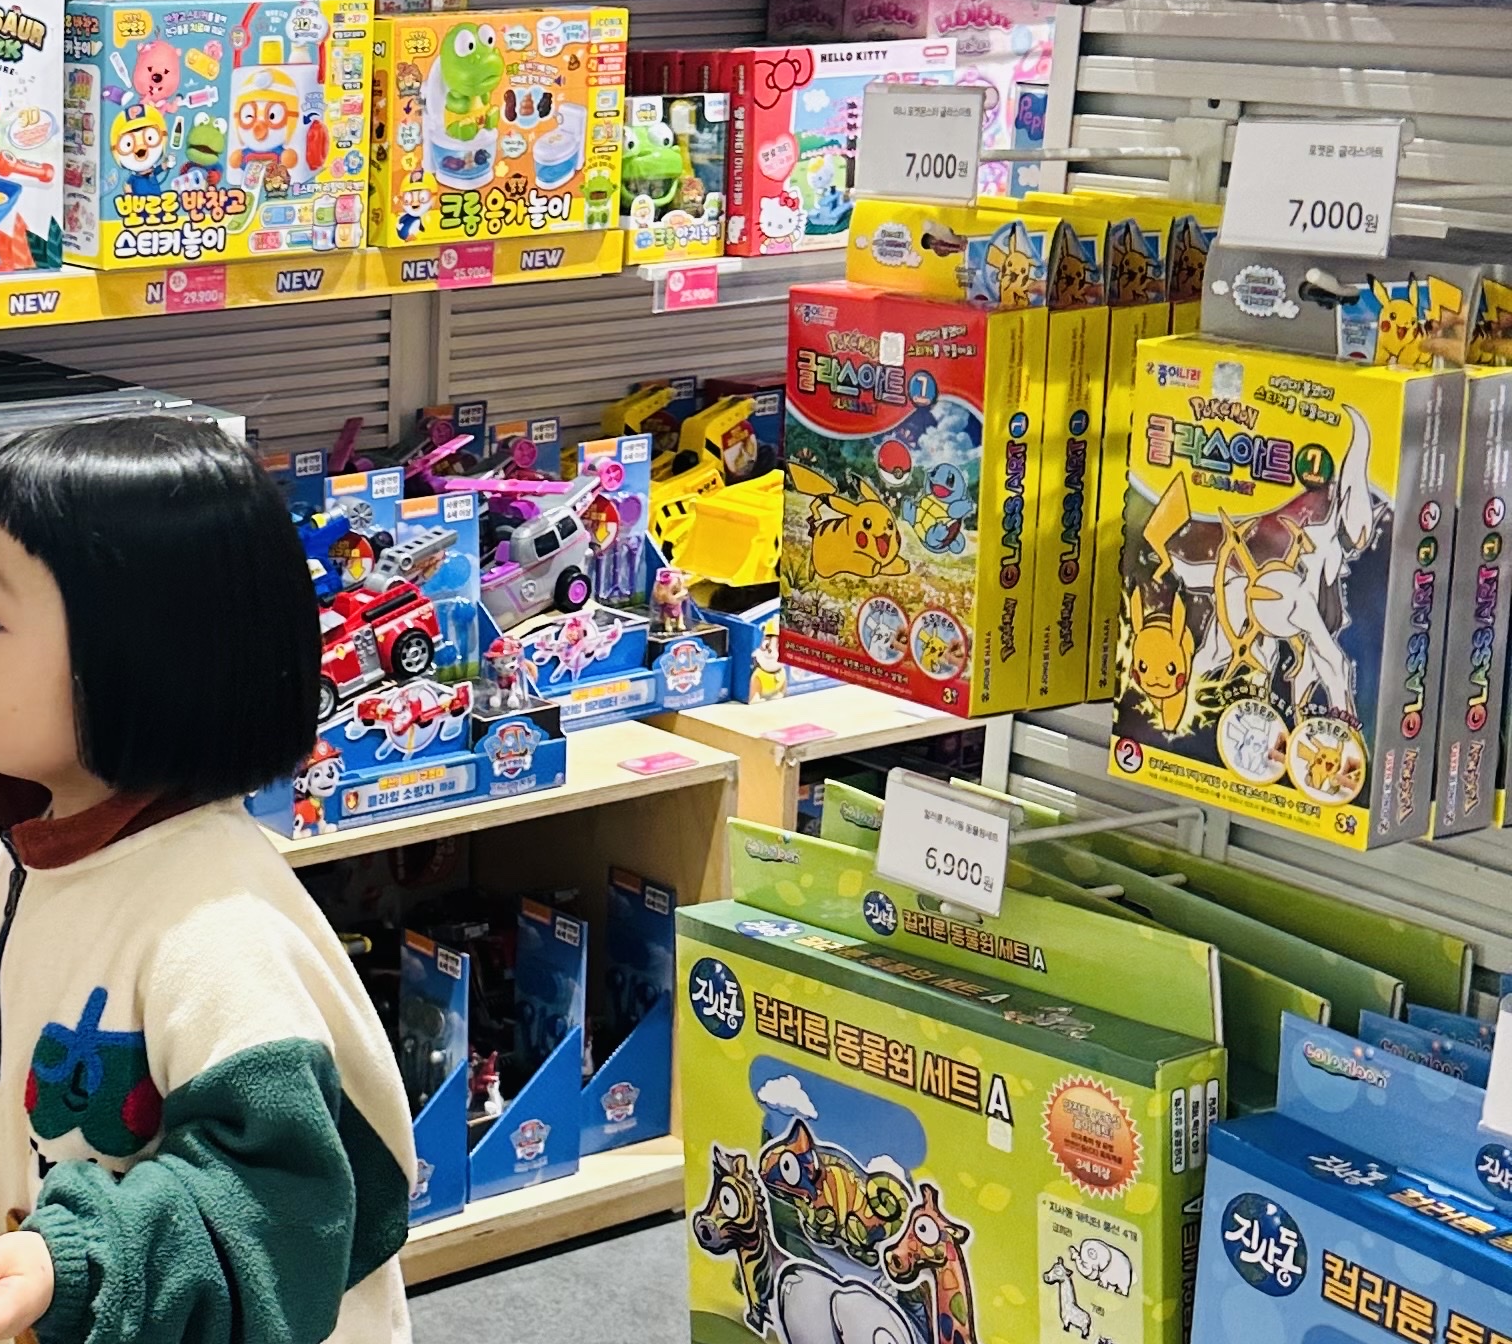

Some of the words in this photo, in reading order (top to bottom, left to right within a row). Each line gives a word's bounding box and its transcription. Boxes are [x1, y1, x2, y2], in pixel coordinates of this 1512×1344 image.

[339, 2, 369, 12] ICONIX
[820, 52, 852, 64] HELLO
[855, 49, 888, 62] KITTY
[17, 106, 41, 126] 3D
[1308, 144, 1334, 158] 포켓몬
[1338, 144, 1384, 159] 글라스아트
[906, 152, 968, 180] 7,000원
[114, 192, 180, 228] 뽀로로
[181, 189, 247, 223] 반창고
[439, 190, 484, 237] 크롱
[1288, 198, 1379, 234] 7,000원
[114, 222, 227, 260] 스티커놀이
[400, 258, 440, 282] NEW
[520, 245, 564, 271] NEW
[276, 267, 325, 293] NEW
[8, 290, 61, 316] NEW
[796, 348, 907, 406] 글라스아트
[1157, 363, 1202, 387] 종이나라
[1145, 413, 1295, 489] 글라스아트
[1236, 704, 1277, 724] 1STEP
[1306, 721, 1351, 743] 2STEP
[1123, 742, 1136, 768] 2
[402, 783, 436, 800] 소방차
[924, 846, 995, 894] 6,900원
[903, 909, 947, 943] 컬러룬
[949, 919, 996, 957] 동물원
[998, 933, 1030, 965] 세트
[1032, 948, 1047, 973] A
[753, 990, 829, 1055] 컬러룬
[831, 1018, 917, 1092] 동물원
[919, 1054, 983, 1116] 세트
[986, 1073, 1015, 1124] A
[1103, 1217, 1121, 1236] 풍선
